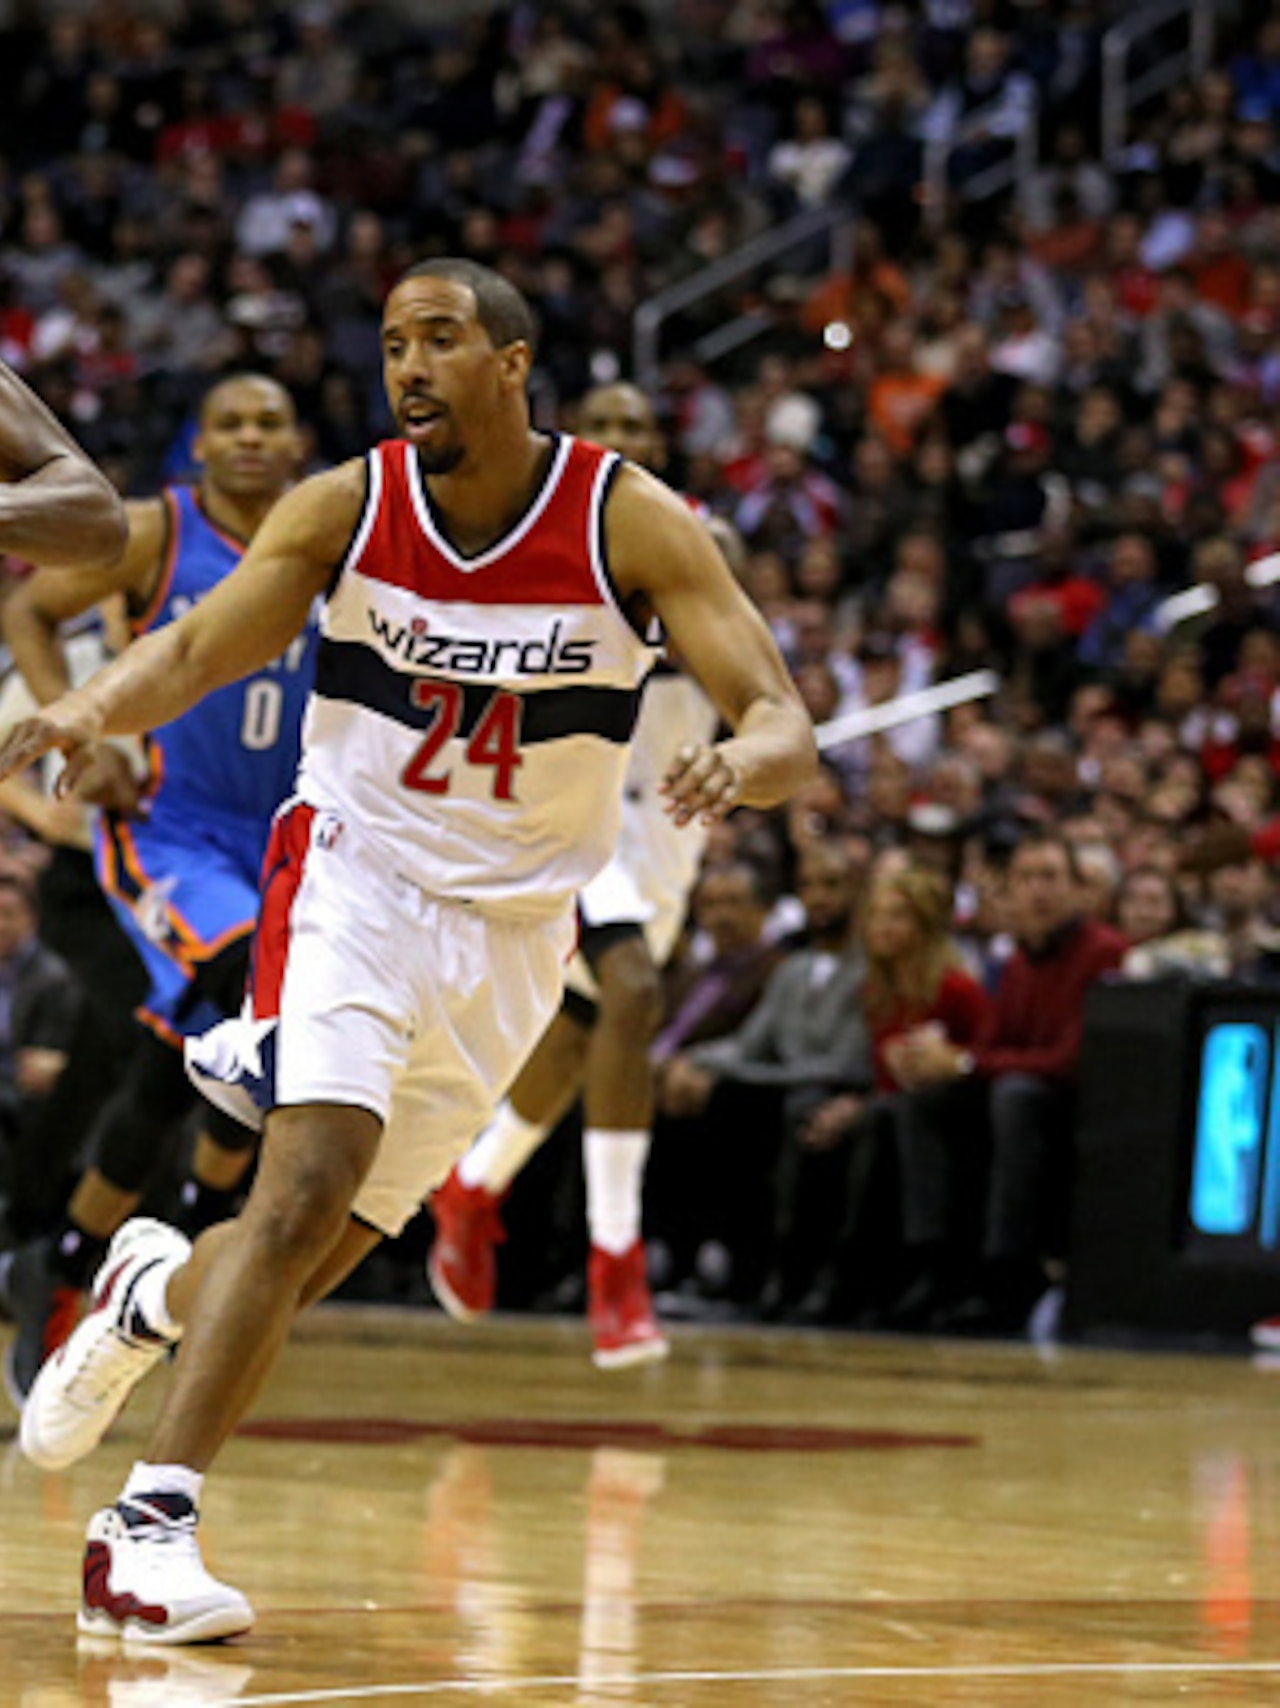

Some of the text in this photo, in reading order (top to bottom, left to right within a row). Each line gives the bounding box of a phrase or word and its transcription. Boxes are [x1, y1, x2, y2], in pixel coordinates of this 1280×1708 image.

[368, 605, 600, 675] wizards
[239, 677, 285, 751] 0
[399, 679, 525, 804] 24
